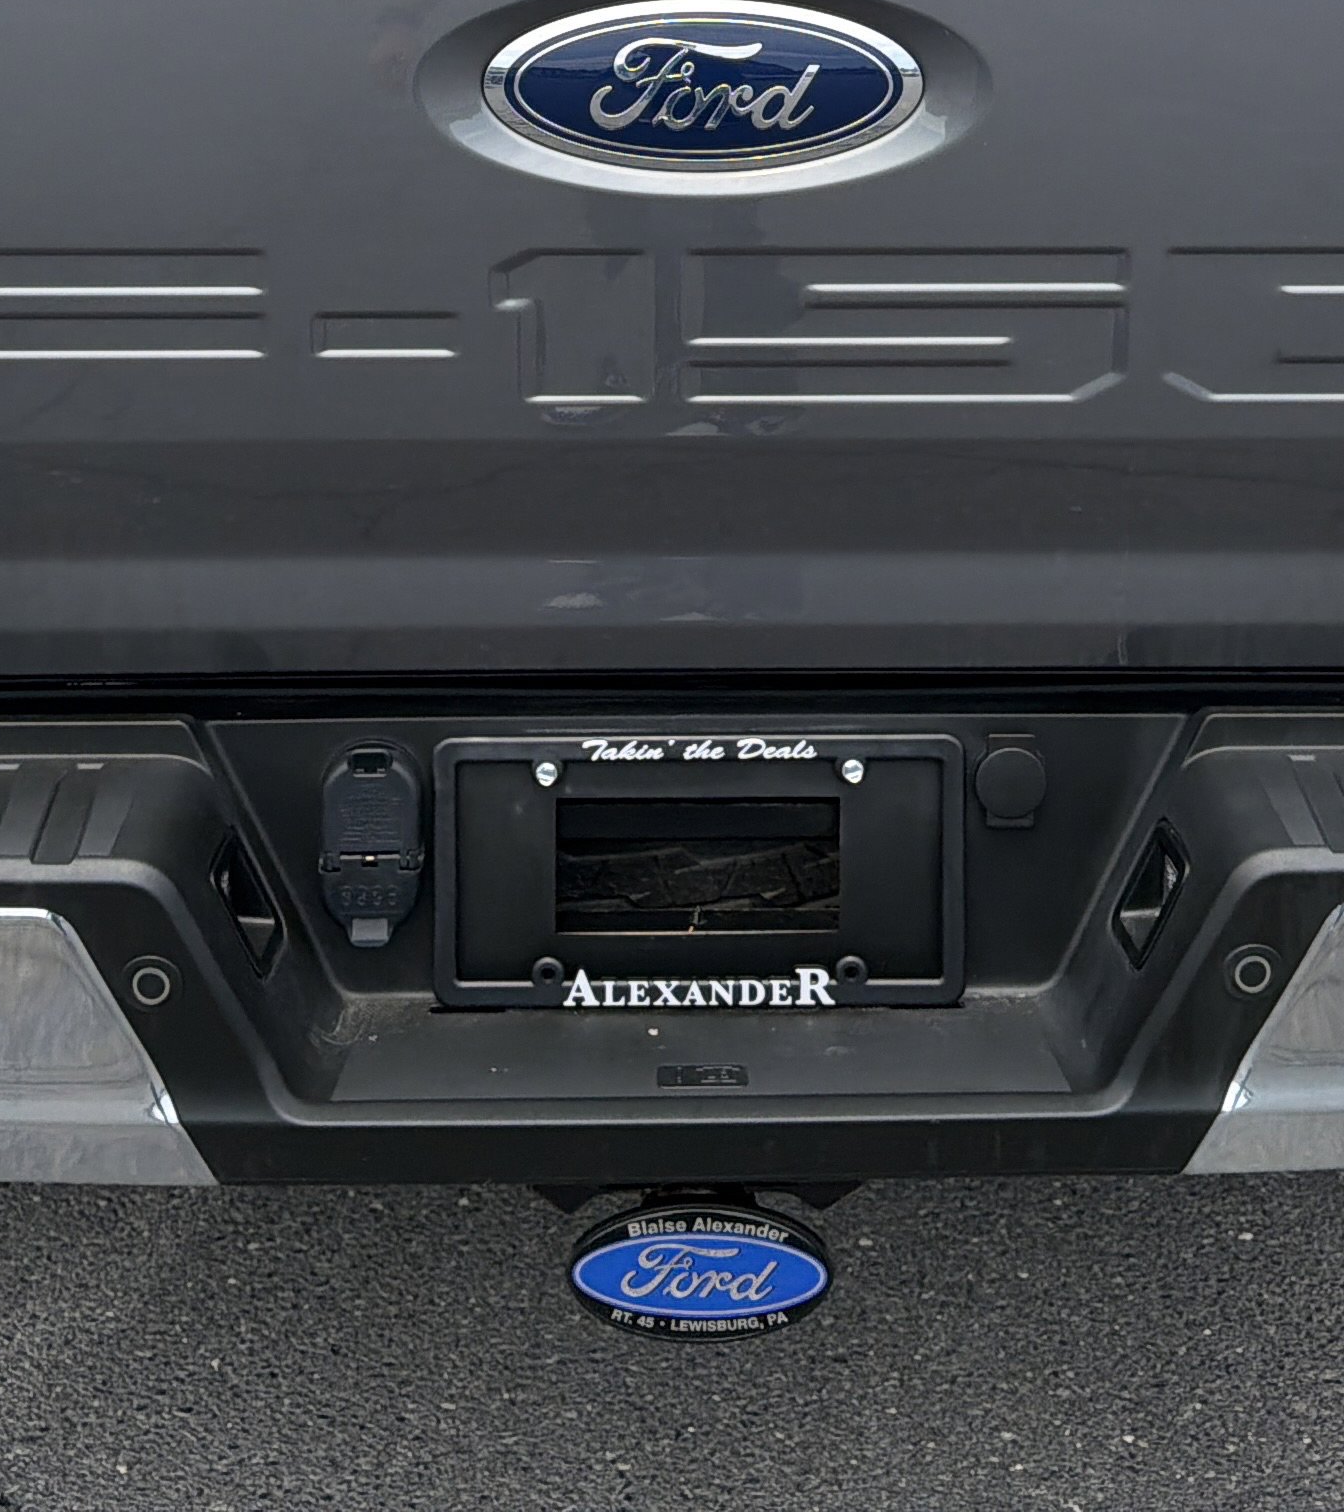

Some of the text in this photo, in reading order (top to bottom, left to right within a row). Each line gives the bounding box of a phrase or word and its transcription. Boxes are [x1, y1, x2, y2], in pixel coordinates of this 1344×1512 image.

[590, 37, 822, 132] Ford
[581, 737, 819, 761] Takin' the Deals
[563, 968, 836, 1007] ALEXANDER
[627, 1217, 790, 1243] Blaise Alexander
[620, 1243, 779, 1302] Ford
[610, 1309, 789, 1333] RT. 45 LEWISBURG, PA
